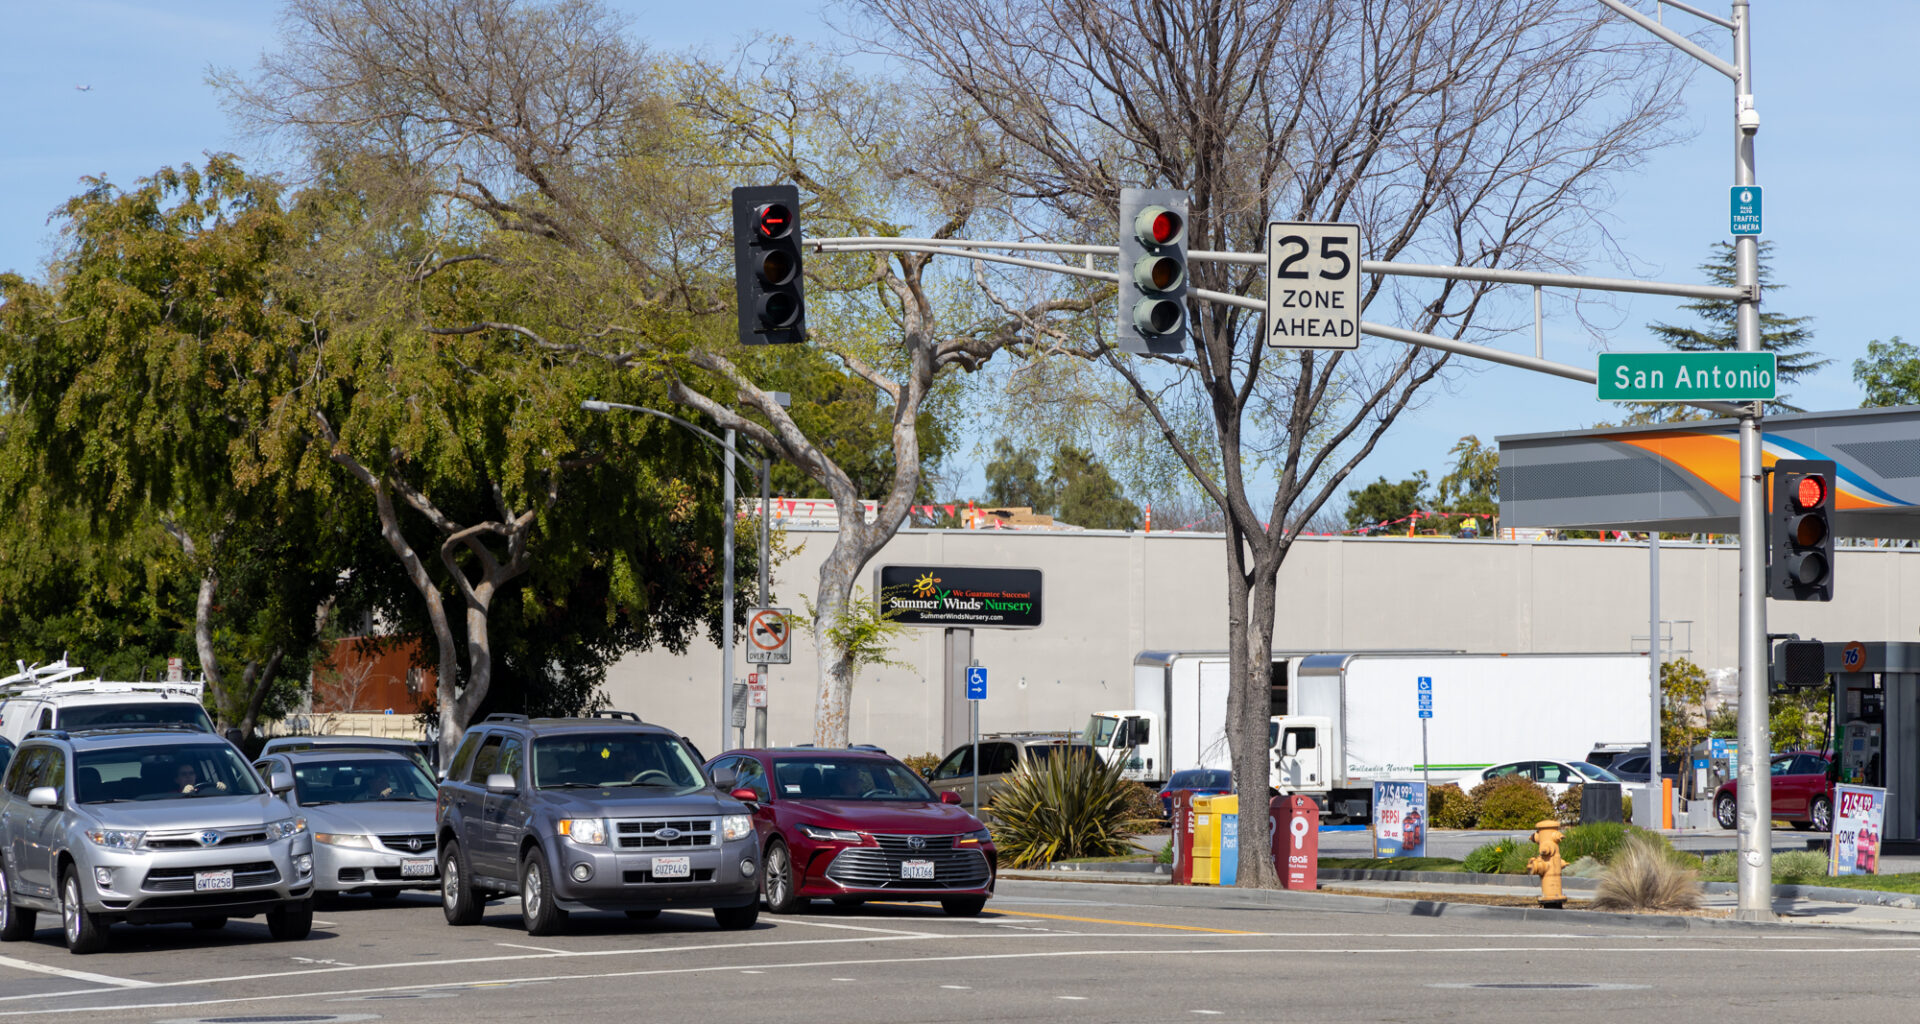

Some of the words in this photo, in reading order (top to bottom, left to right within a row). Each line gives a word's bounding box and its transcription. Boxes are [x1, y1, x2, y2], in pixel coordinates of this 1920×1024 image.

[1277, 235, 1351, 280] 25
[1282, 290, 1344, 308] ZONE
[1272, 318, 1354, 338] AHEAD
[1614, 365, 1664, 390] San
[1674, 365, 1771, 389] Antonio
[890, 596, 939, 610] Summer
[985, 599, 1032, 615] Nursery
[920, 612, 1004, 622] SummerWindsNursery.com
[766, 652, 772, 660] 7
[1844, 647, 1859, 664] 76
[1386, 764, 1412, 772] Nursery
[1382, 810, 1400, 824] PEPSI
[1223, 836, 1236, 848] Post
[1840, 830, 1854, 844] COKE
[655, 864, 688, 874] 6UZP449
